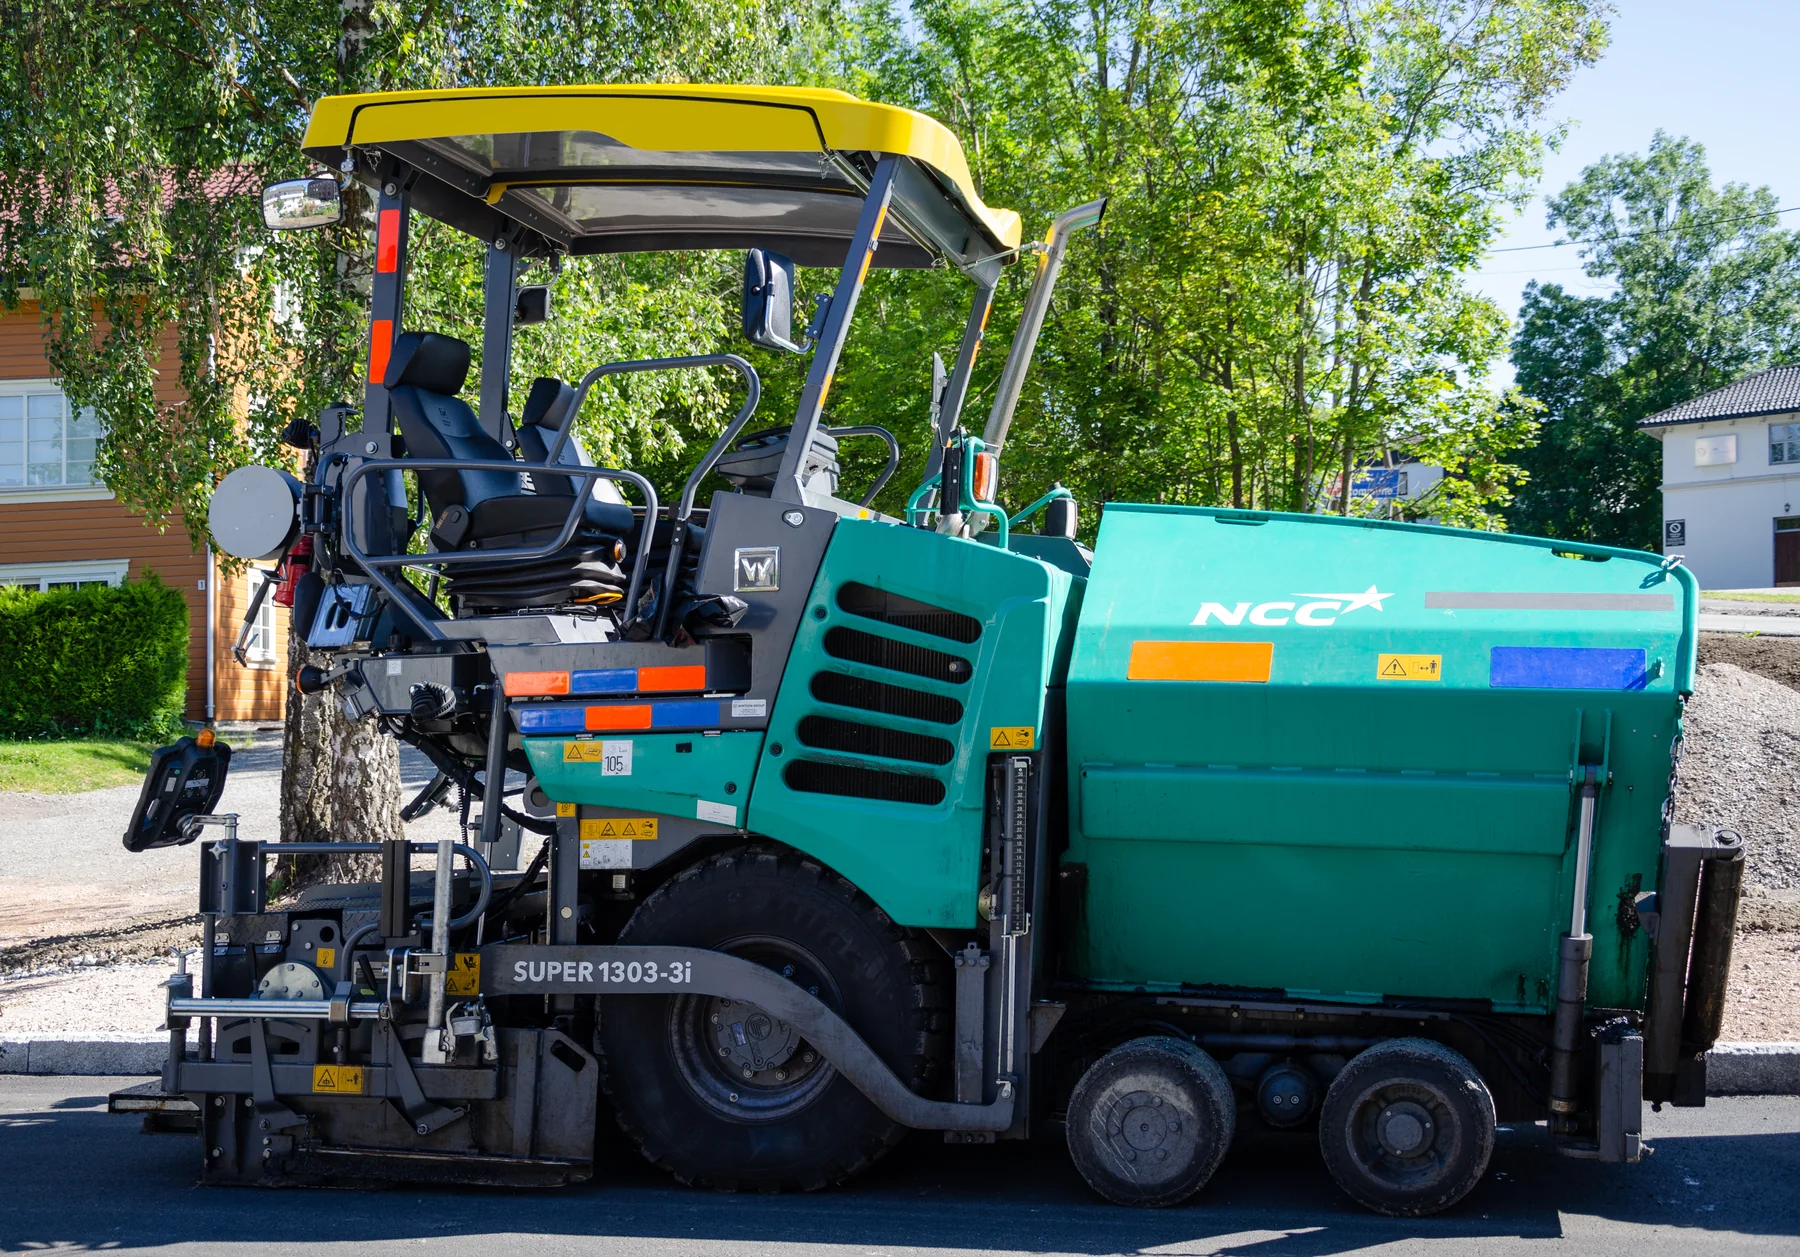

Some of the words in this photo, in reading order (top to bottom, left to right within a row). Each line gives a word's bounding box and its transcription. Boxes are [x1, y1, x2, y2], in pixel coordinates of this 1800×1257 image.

[1189, 601, 1342, 627] NCC
[605, 755, 624, 772] 105
[513, 961, 594, 982] SUPER
[598, 961, 691, 983] 1303-3i
